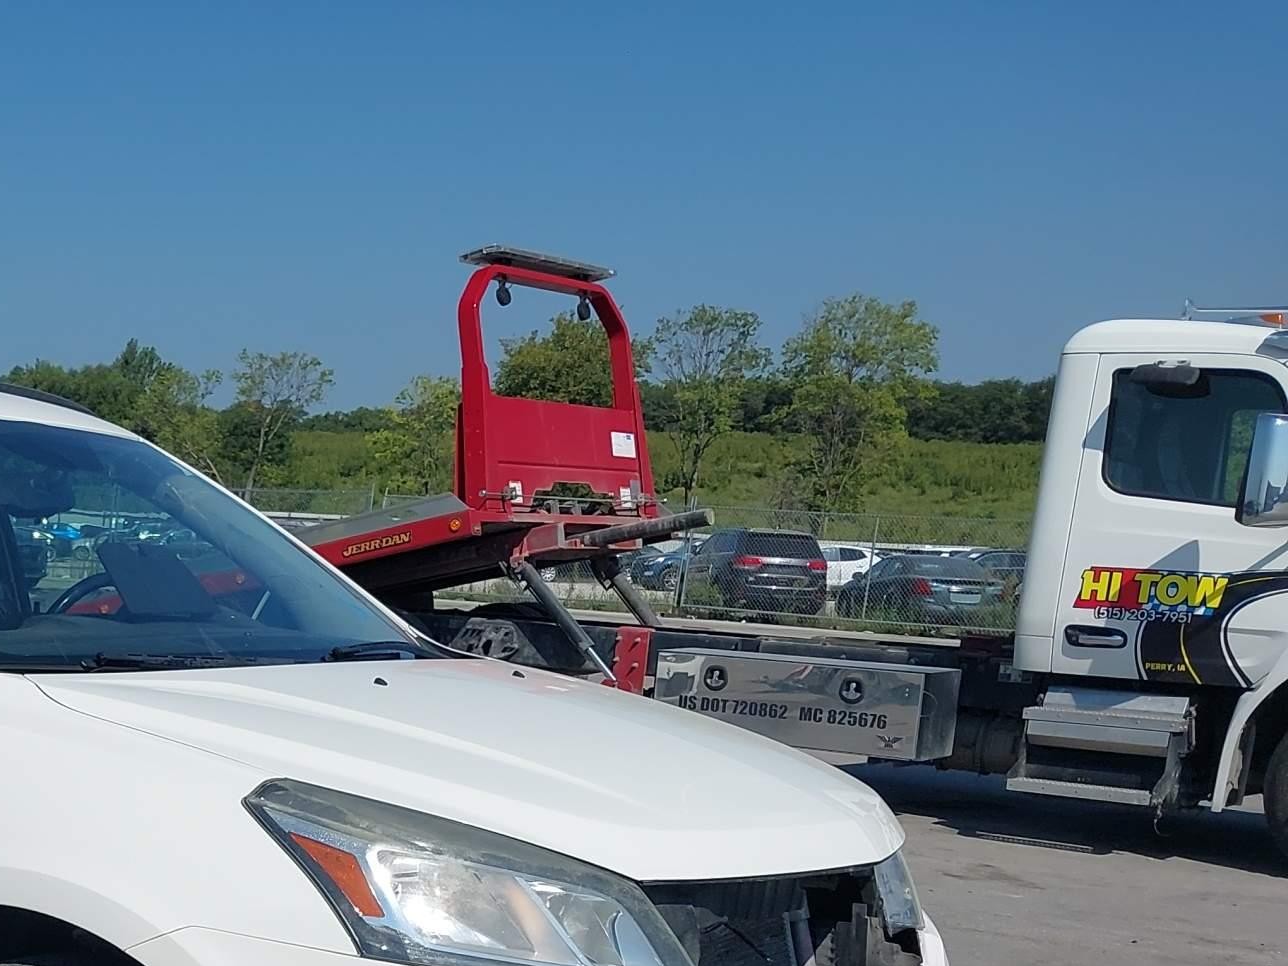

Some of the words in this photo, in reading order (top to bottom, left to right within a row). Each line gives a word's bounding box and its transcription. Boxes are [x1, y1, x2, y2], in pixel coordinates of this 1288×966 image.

[1081, 569, 1123, 602] HI
[1135, 572, 1229, 609] TOW
[1094, 606, 1126, 620] (515)
[1128, 608, 1192, 624] 203-7951
[678, 694, 697, 710] US
[700, 697, 729, 714] DOT
[731, 699, 788, 720] 720862
[799, 706, 823, 723] MC
[827, 708, 888, 730] 825676
